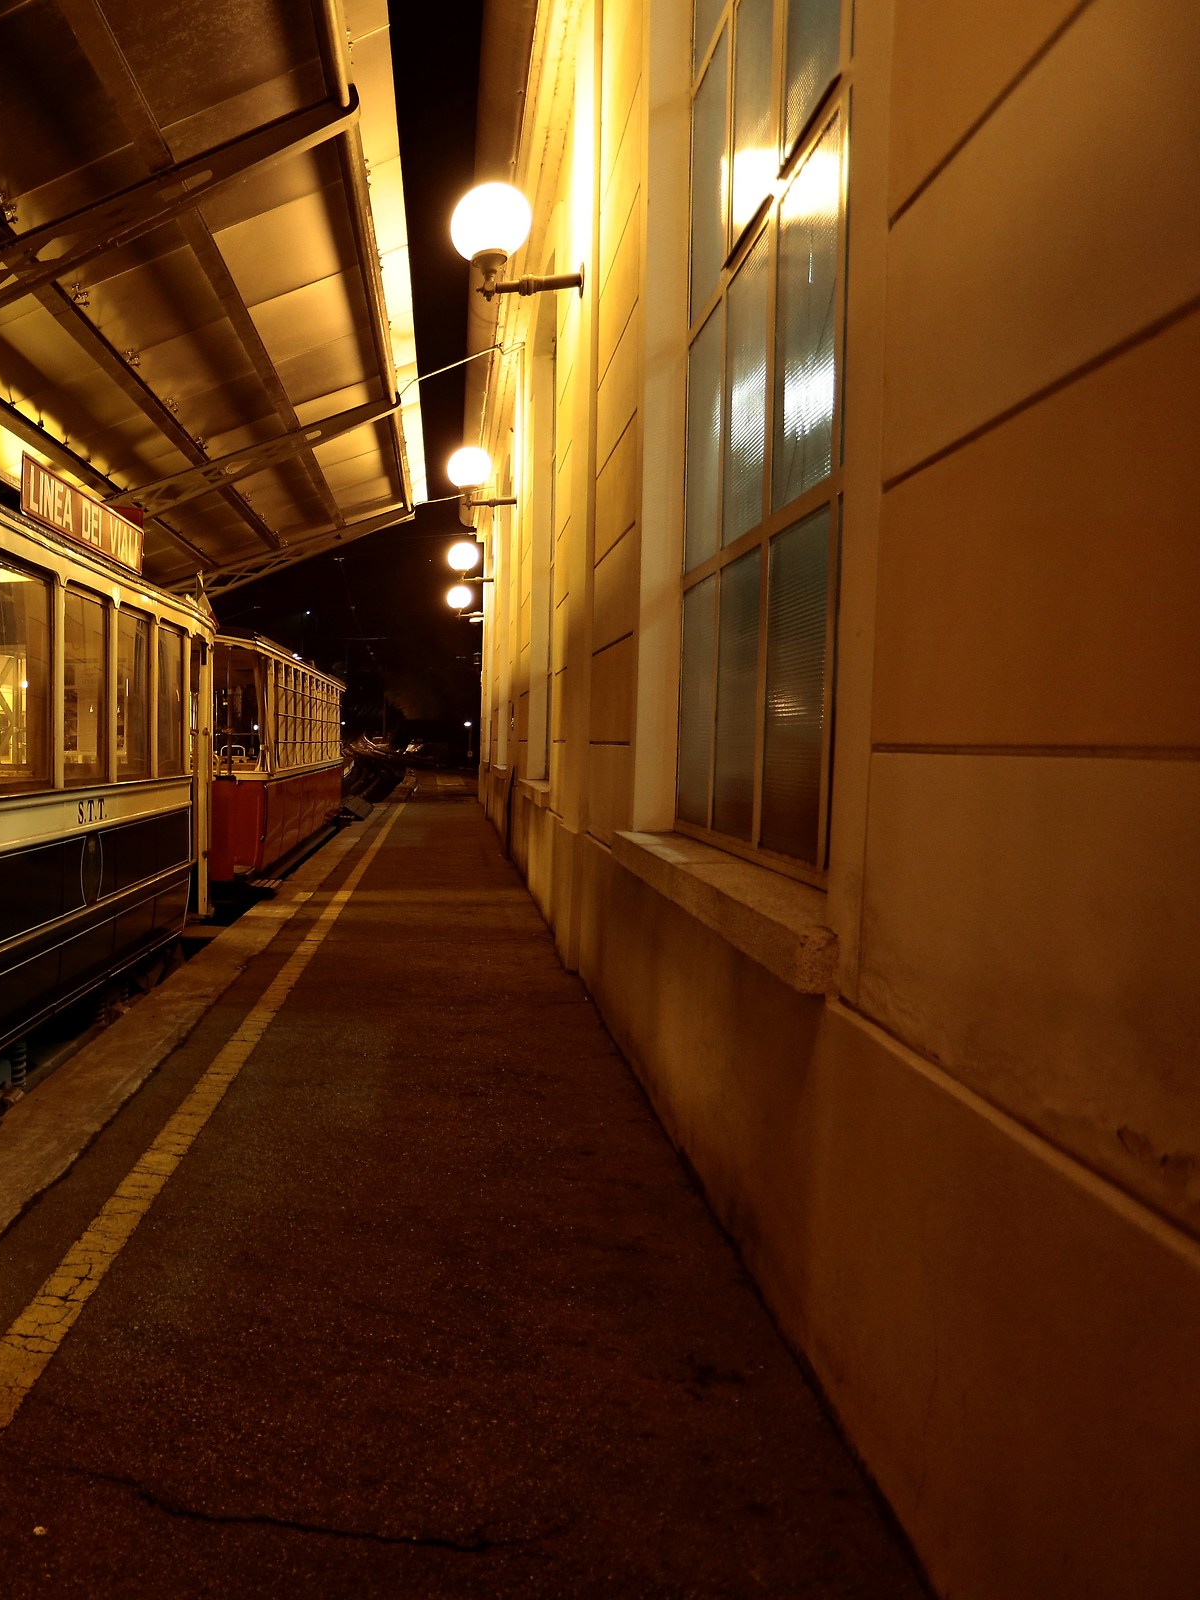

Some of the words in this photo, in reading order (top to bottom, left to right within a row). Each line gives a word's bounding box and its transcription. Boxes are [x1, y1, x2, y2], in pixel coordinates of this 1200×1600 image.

[29, 464, 73, 533] LINEA
[81, 498, 102, 547] DEI
[109, 515, 138, 567] VIALI
[78, 798, 107, 824] S.T.T.
